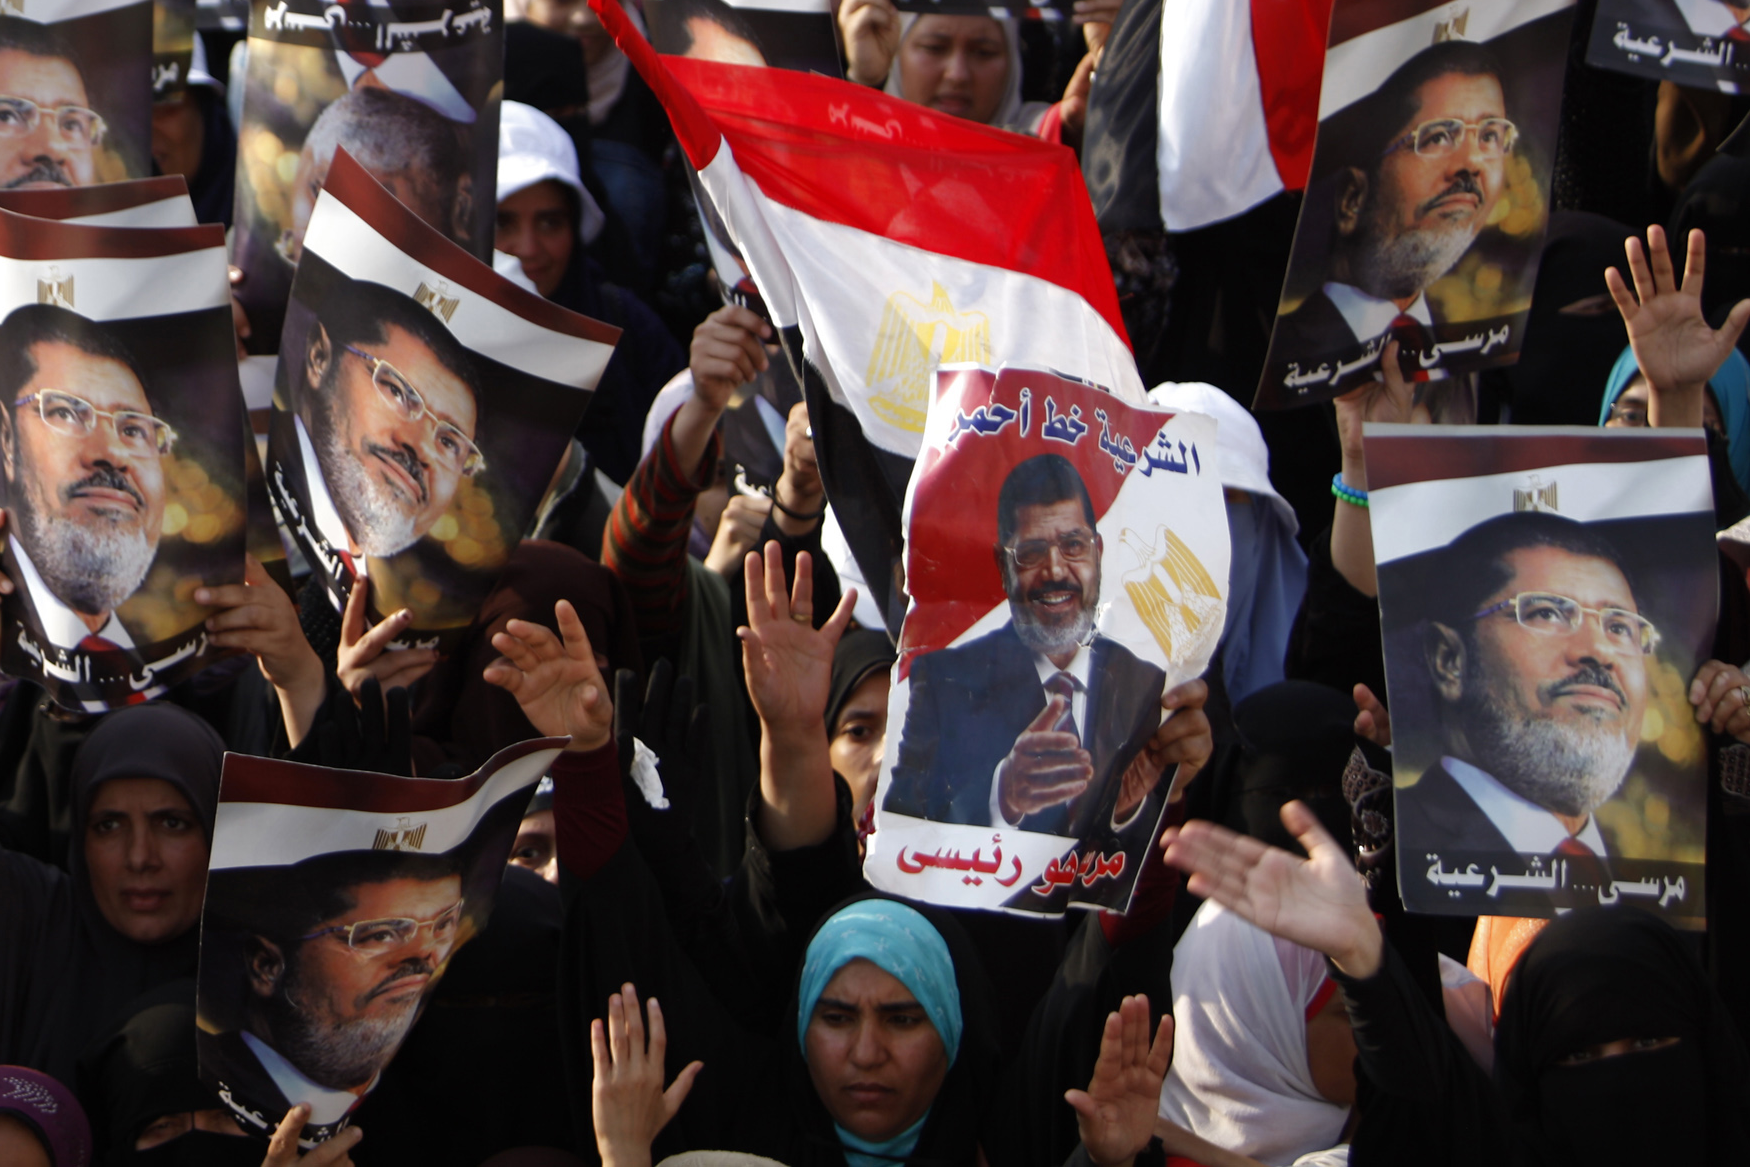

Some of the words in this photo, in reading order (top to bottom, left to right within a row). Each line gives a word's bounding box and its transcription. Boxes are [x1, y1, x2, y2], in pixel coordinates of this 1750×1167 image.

[1614, 21, 1734, 66] الشرعية
[1284, 333, 1390, 393] الشرعية
[945, 385, 1031, 443] أحمر
[1040, 394, 1086, 445] خط
[1094, 406, 1199, 477] الشرعية
[896, 833, 1023, 887] رئيسى
[1032, 850, 1079, 895] هو
[1425, 853, 1567, 896] الشرعية
